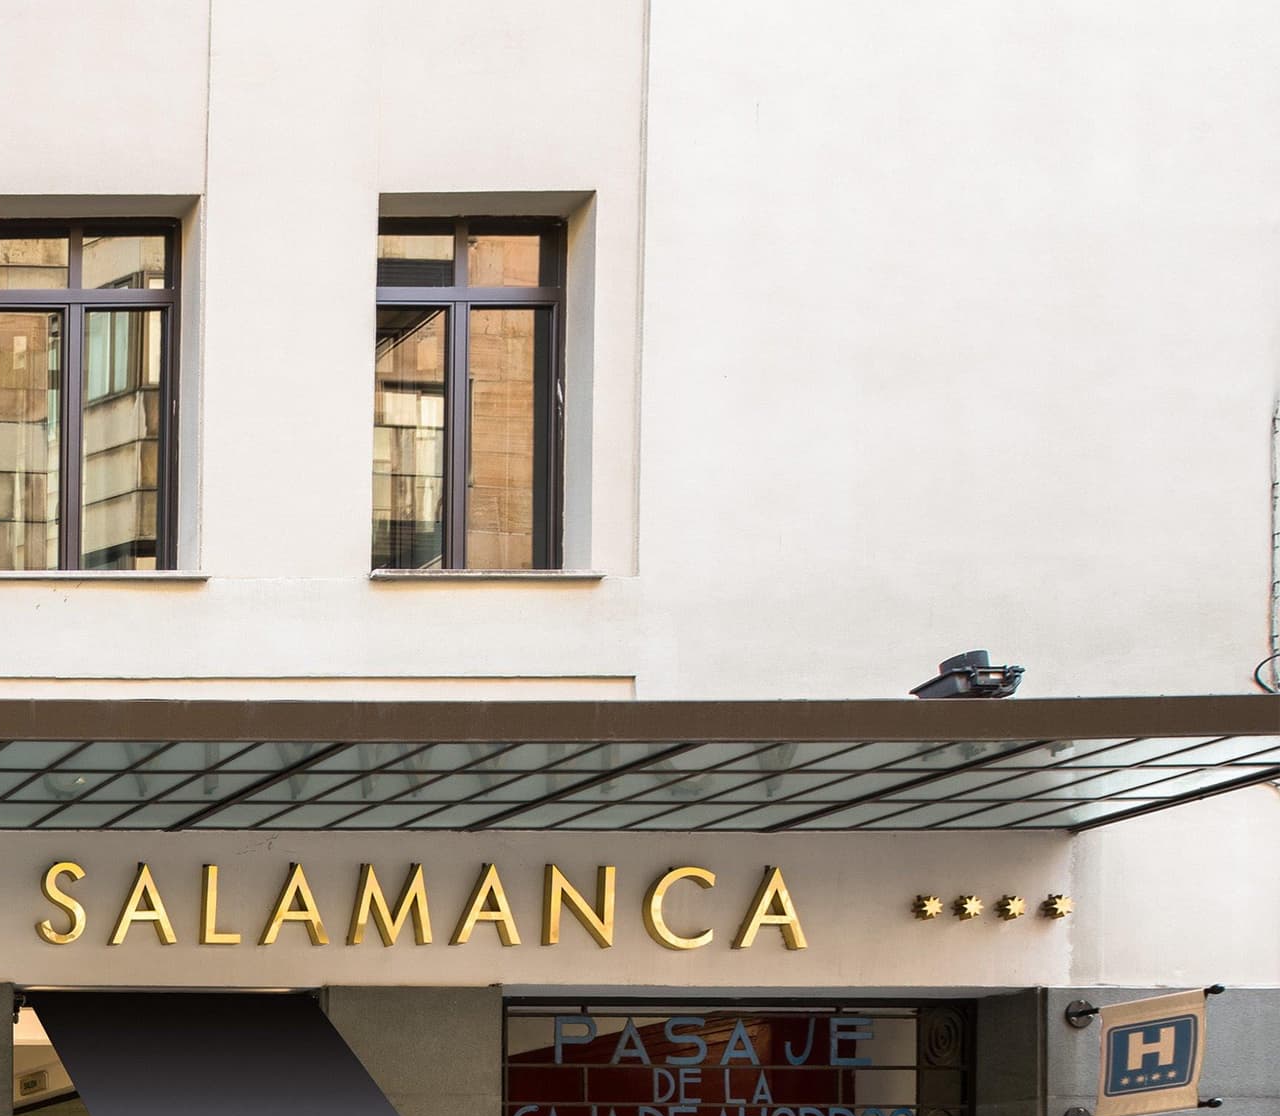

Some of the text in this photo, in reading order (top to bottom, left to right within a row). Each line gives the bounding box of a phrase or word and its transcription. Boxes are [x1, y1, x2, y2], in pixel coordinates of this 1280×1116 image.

[36, 861, 807, 951] SALAMANCA
[554, 1016, 874, 1066] PASAJE
[1127, 1026, 1175, 1071] H
[653, 1068, 773, 1104] DE LA
